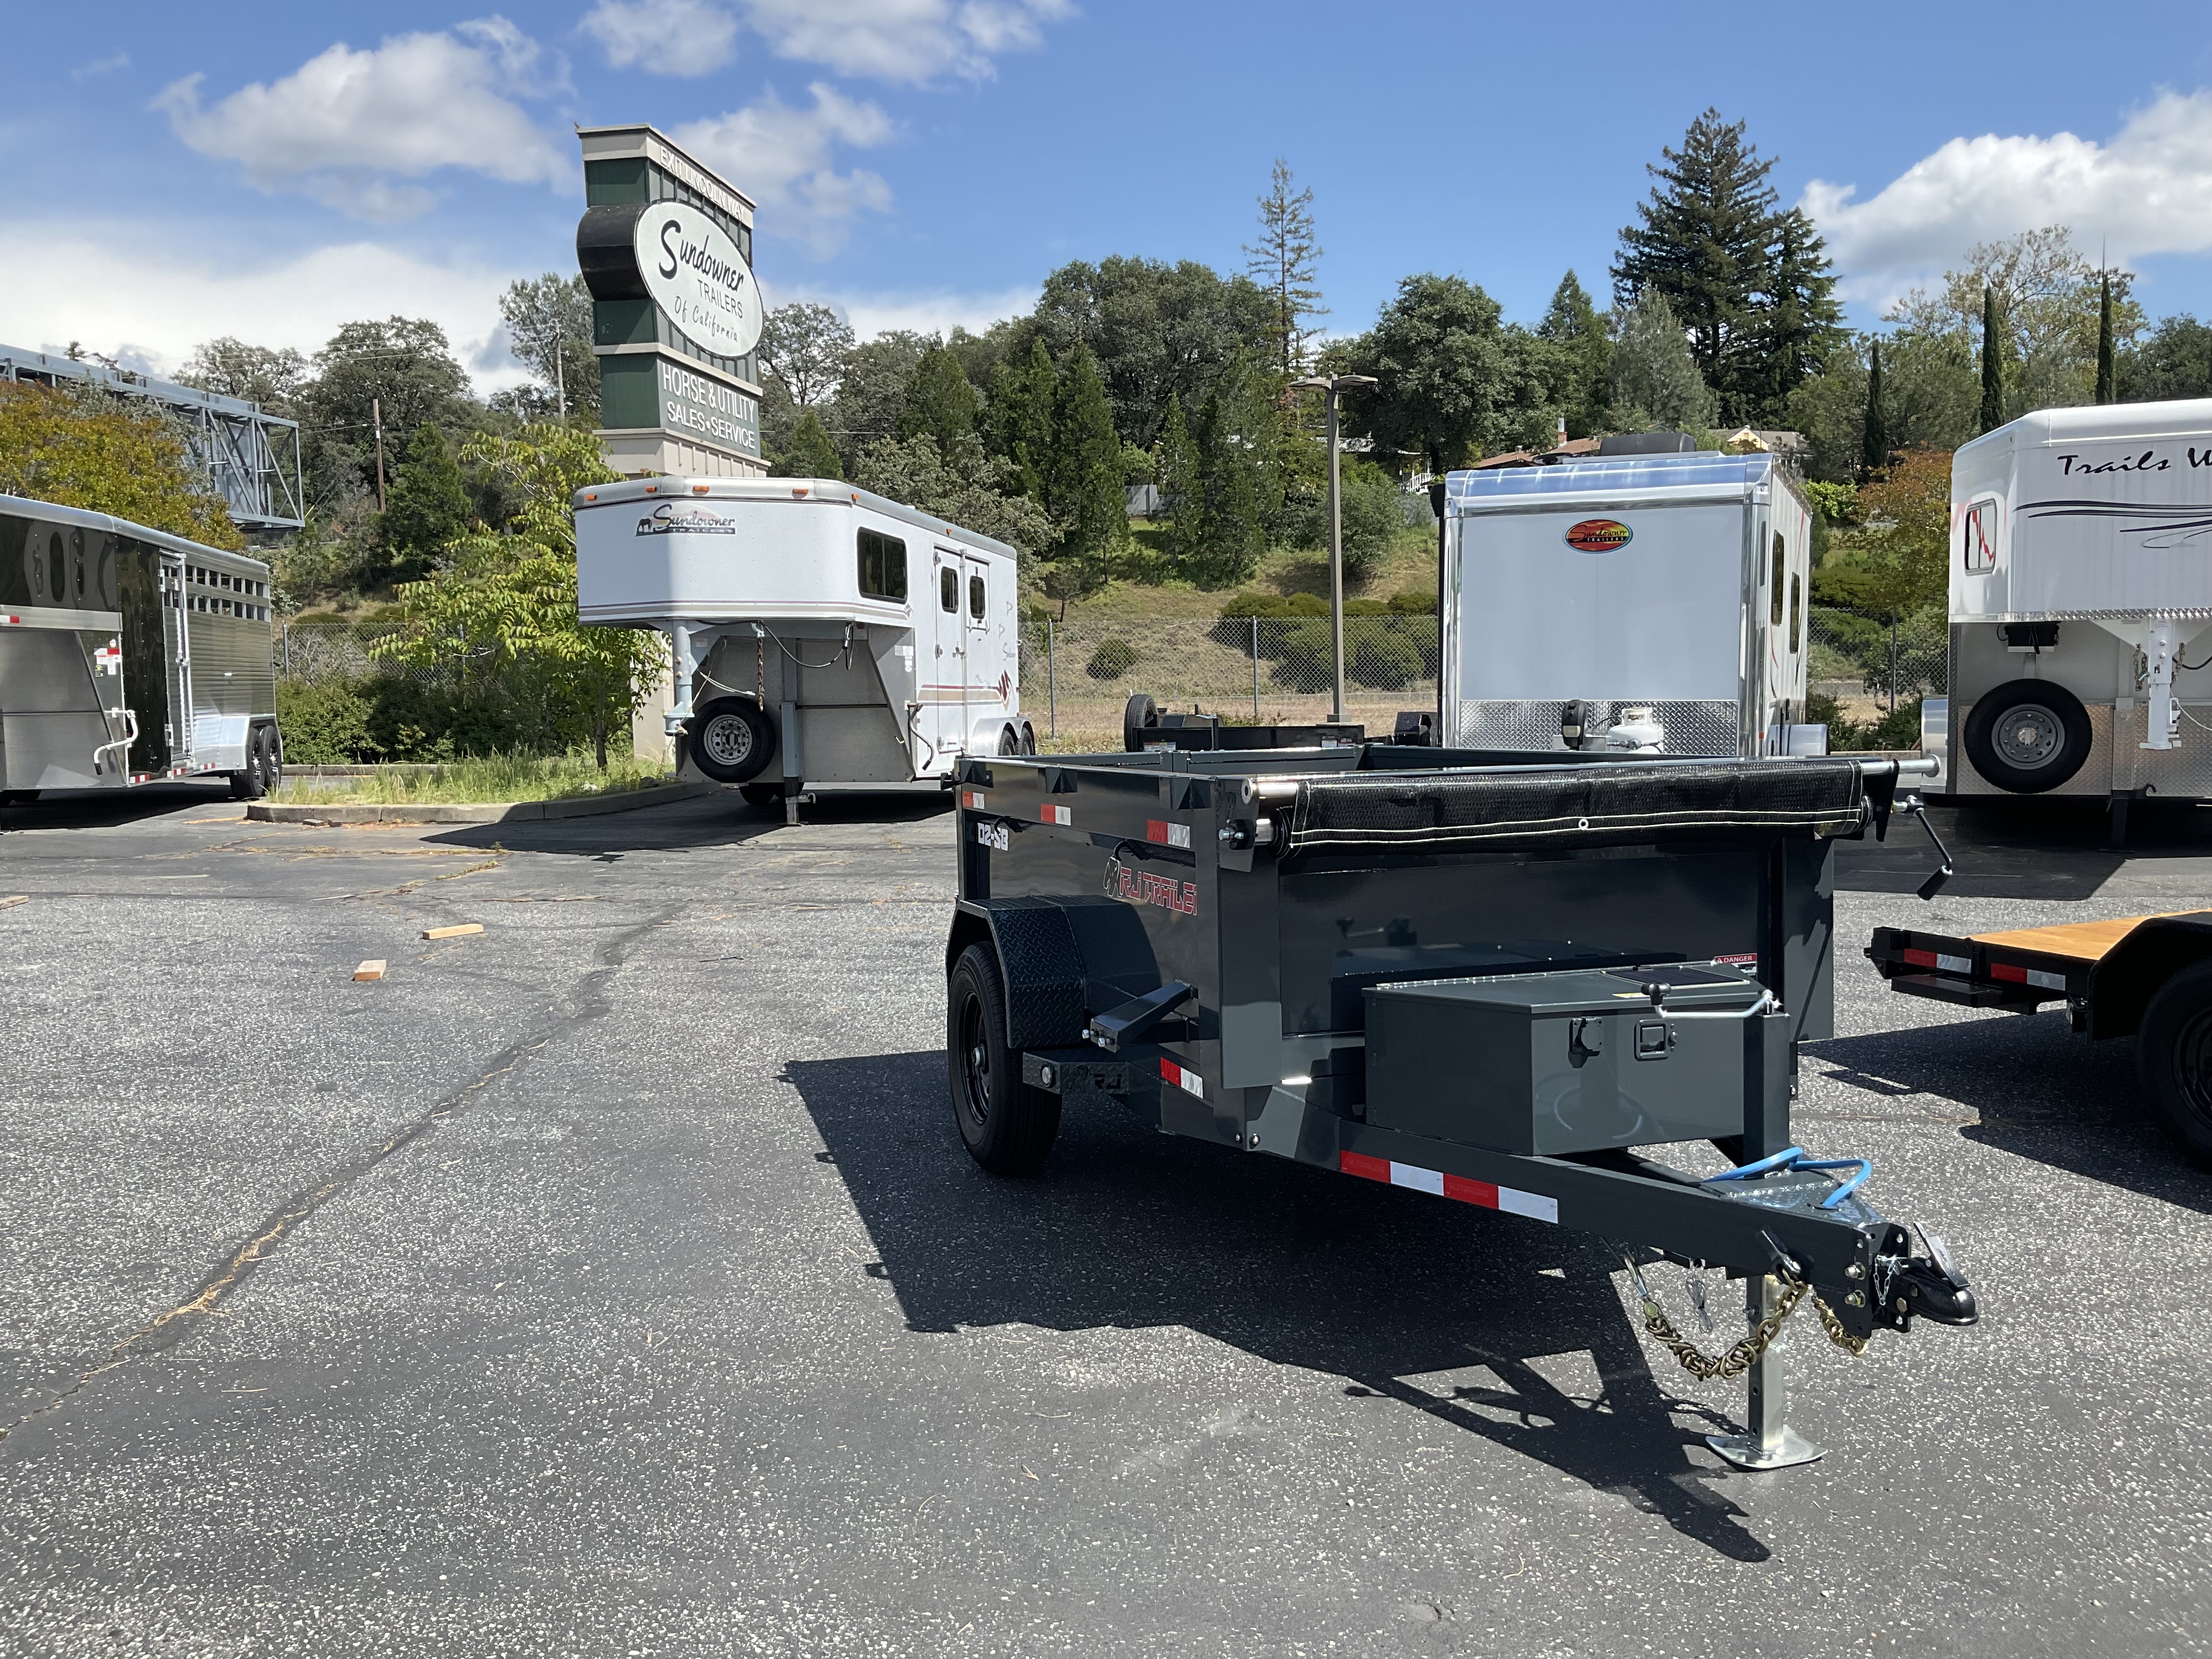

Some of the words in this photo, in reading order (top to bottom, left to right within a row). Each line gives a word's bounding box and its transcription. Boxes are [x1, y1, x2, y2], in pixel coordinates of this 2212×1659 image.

[660, 145, 684, 179] EXIT
[685, 161, 726, 207] LINCOLN
[726, 195, 746, 221] WAY
[658, 219, 744, 292] Sundowner
[697, 279, 743, 319] TRAILERS
[674, 296, 688, 323] Of
[692, 305, 738, 343] California
[663, 363, 706, 405] HORSE
[708, 382, 717, 409] &
[717, 385, 755, 424] UTILITY
[2057, 450, 2171, 476] Trails
[653, 504, 735, 531] Sundowner
[1570, 524, 1627, 541] Sundowner
[1119, 867, 1142, 900] RJ
